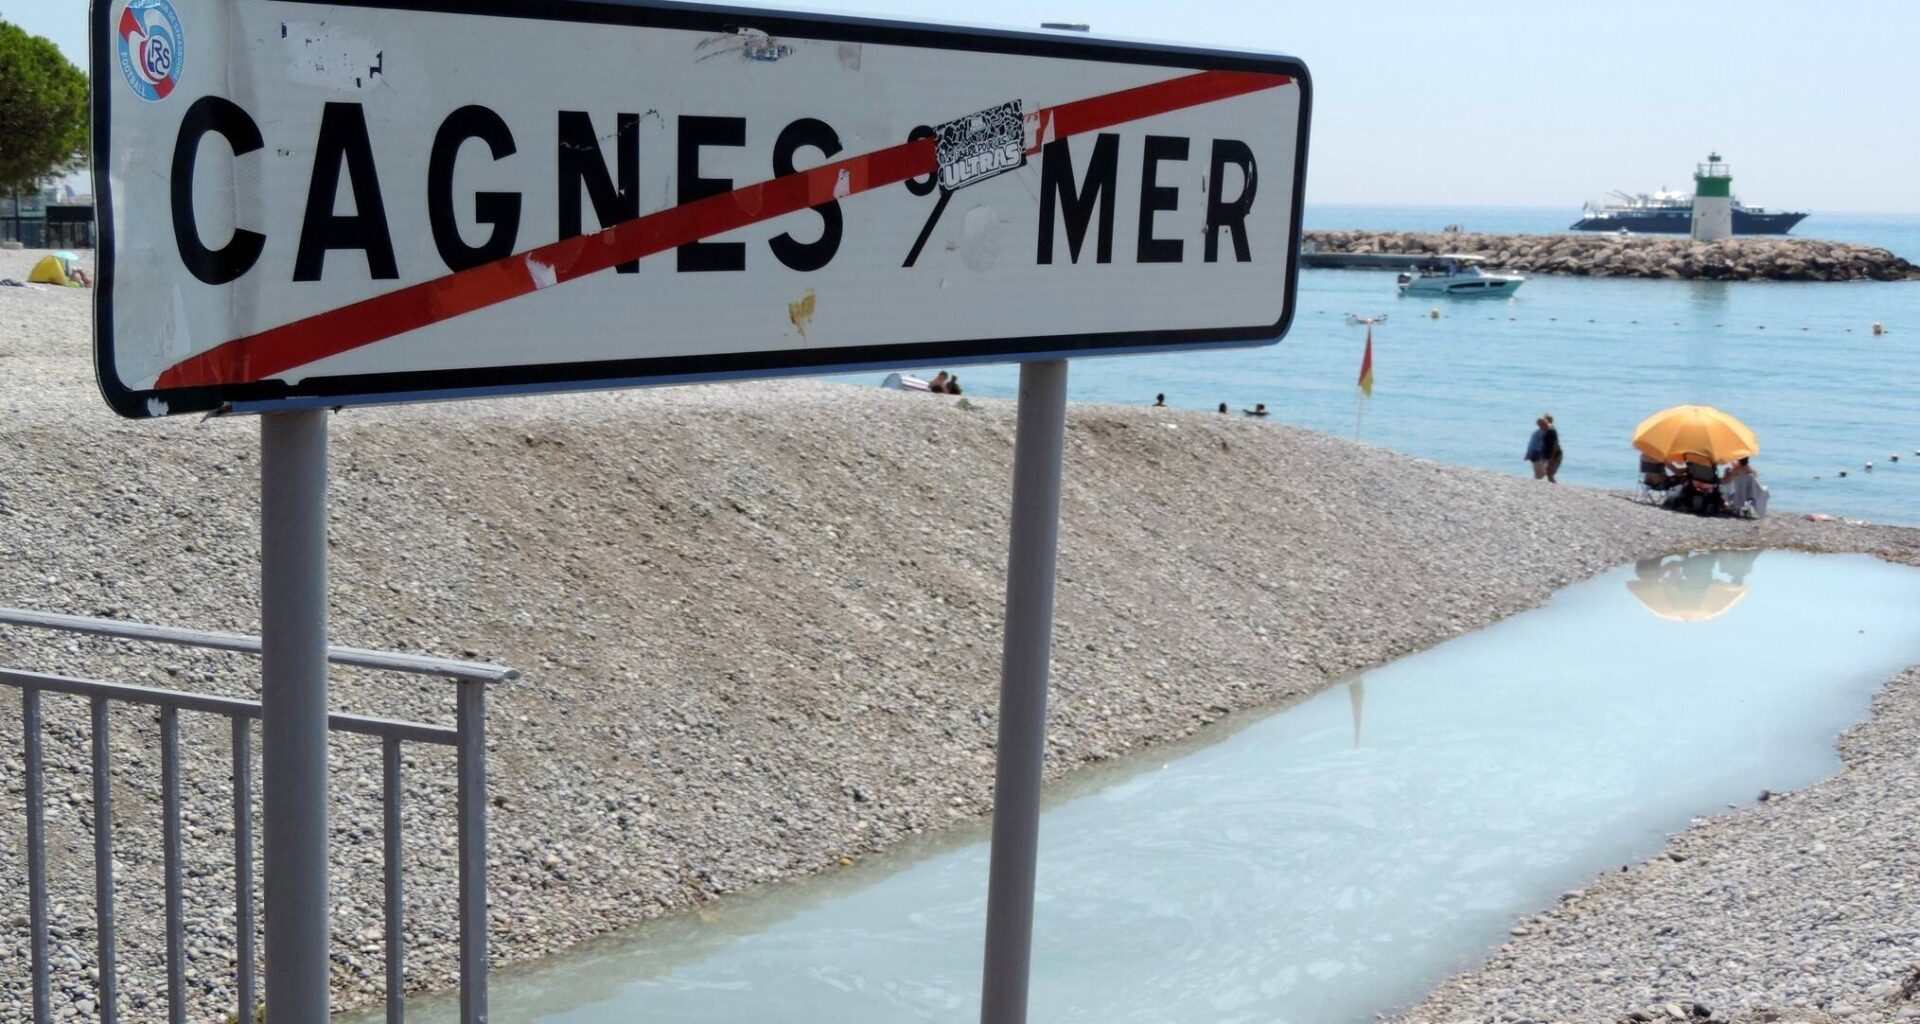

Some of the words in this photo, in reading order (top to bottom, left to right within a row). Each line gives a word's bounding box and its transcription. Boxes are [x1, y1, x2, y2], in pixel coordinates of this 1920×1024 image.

[120, 51, 146, 97] FOOTBALL
[944, 142, 1020, 185] ULTRAS
[170, 95, 843, 285] CAGNES
[1036, 133, 1258, 265] MER
